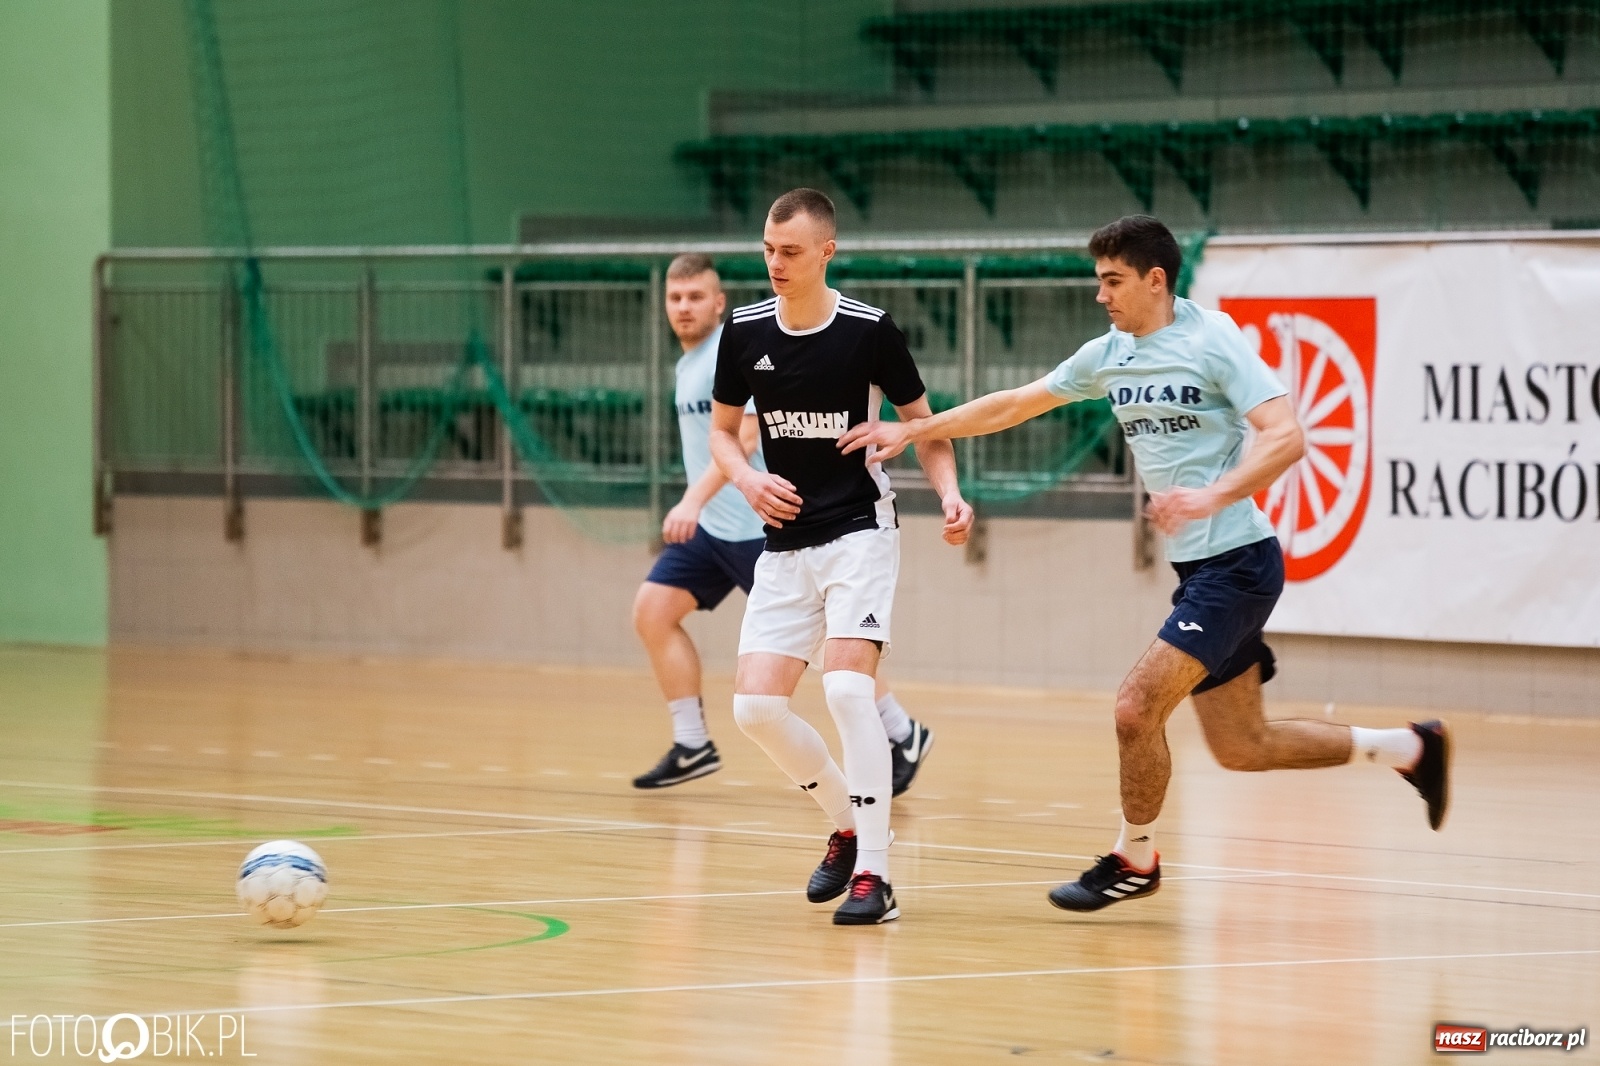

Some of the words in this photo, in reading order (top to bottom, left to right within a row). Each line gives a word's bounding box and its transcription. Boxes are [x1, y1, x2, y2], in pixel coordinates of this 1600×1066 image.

[1422, 362, 1600, 425] MIAST
[782, 429, 804, 437] PRD
[785, 411, 849, 430] KUHN
[1388, 441, 1600, 524] RACIBÓ
